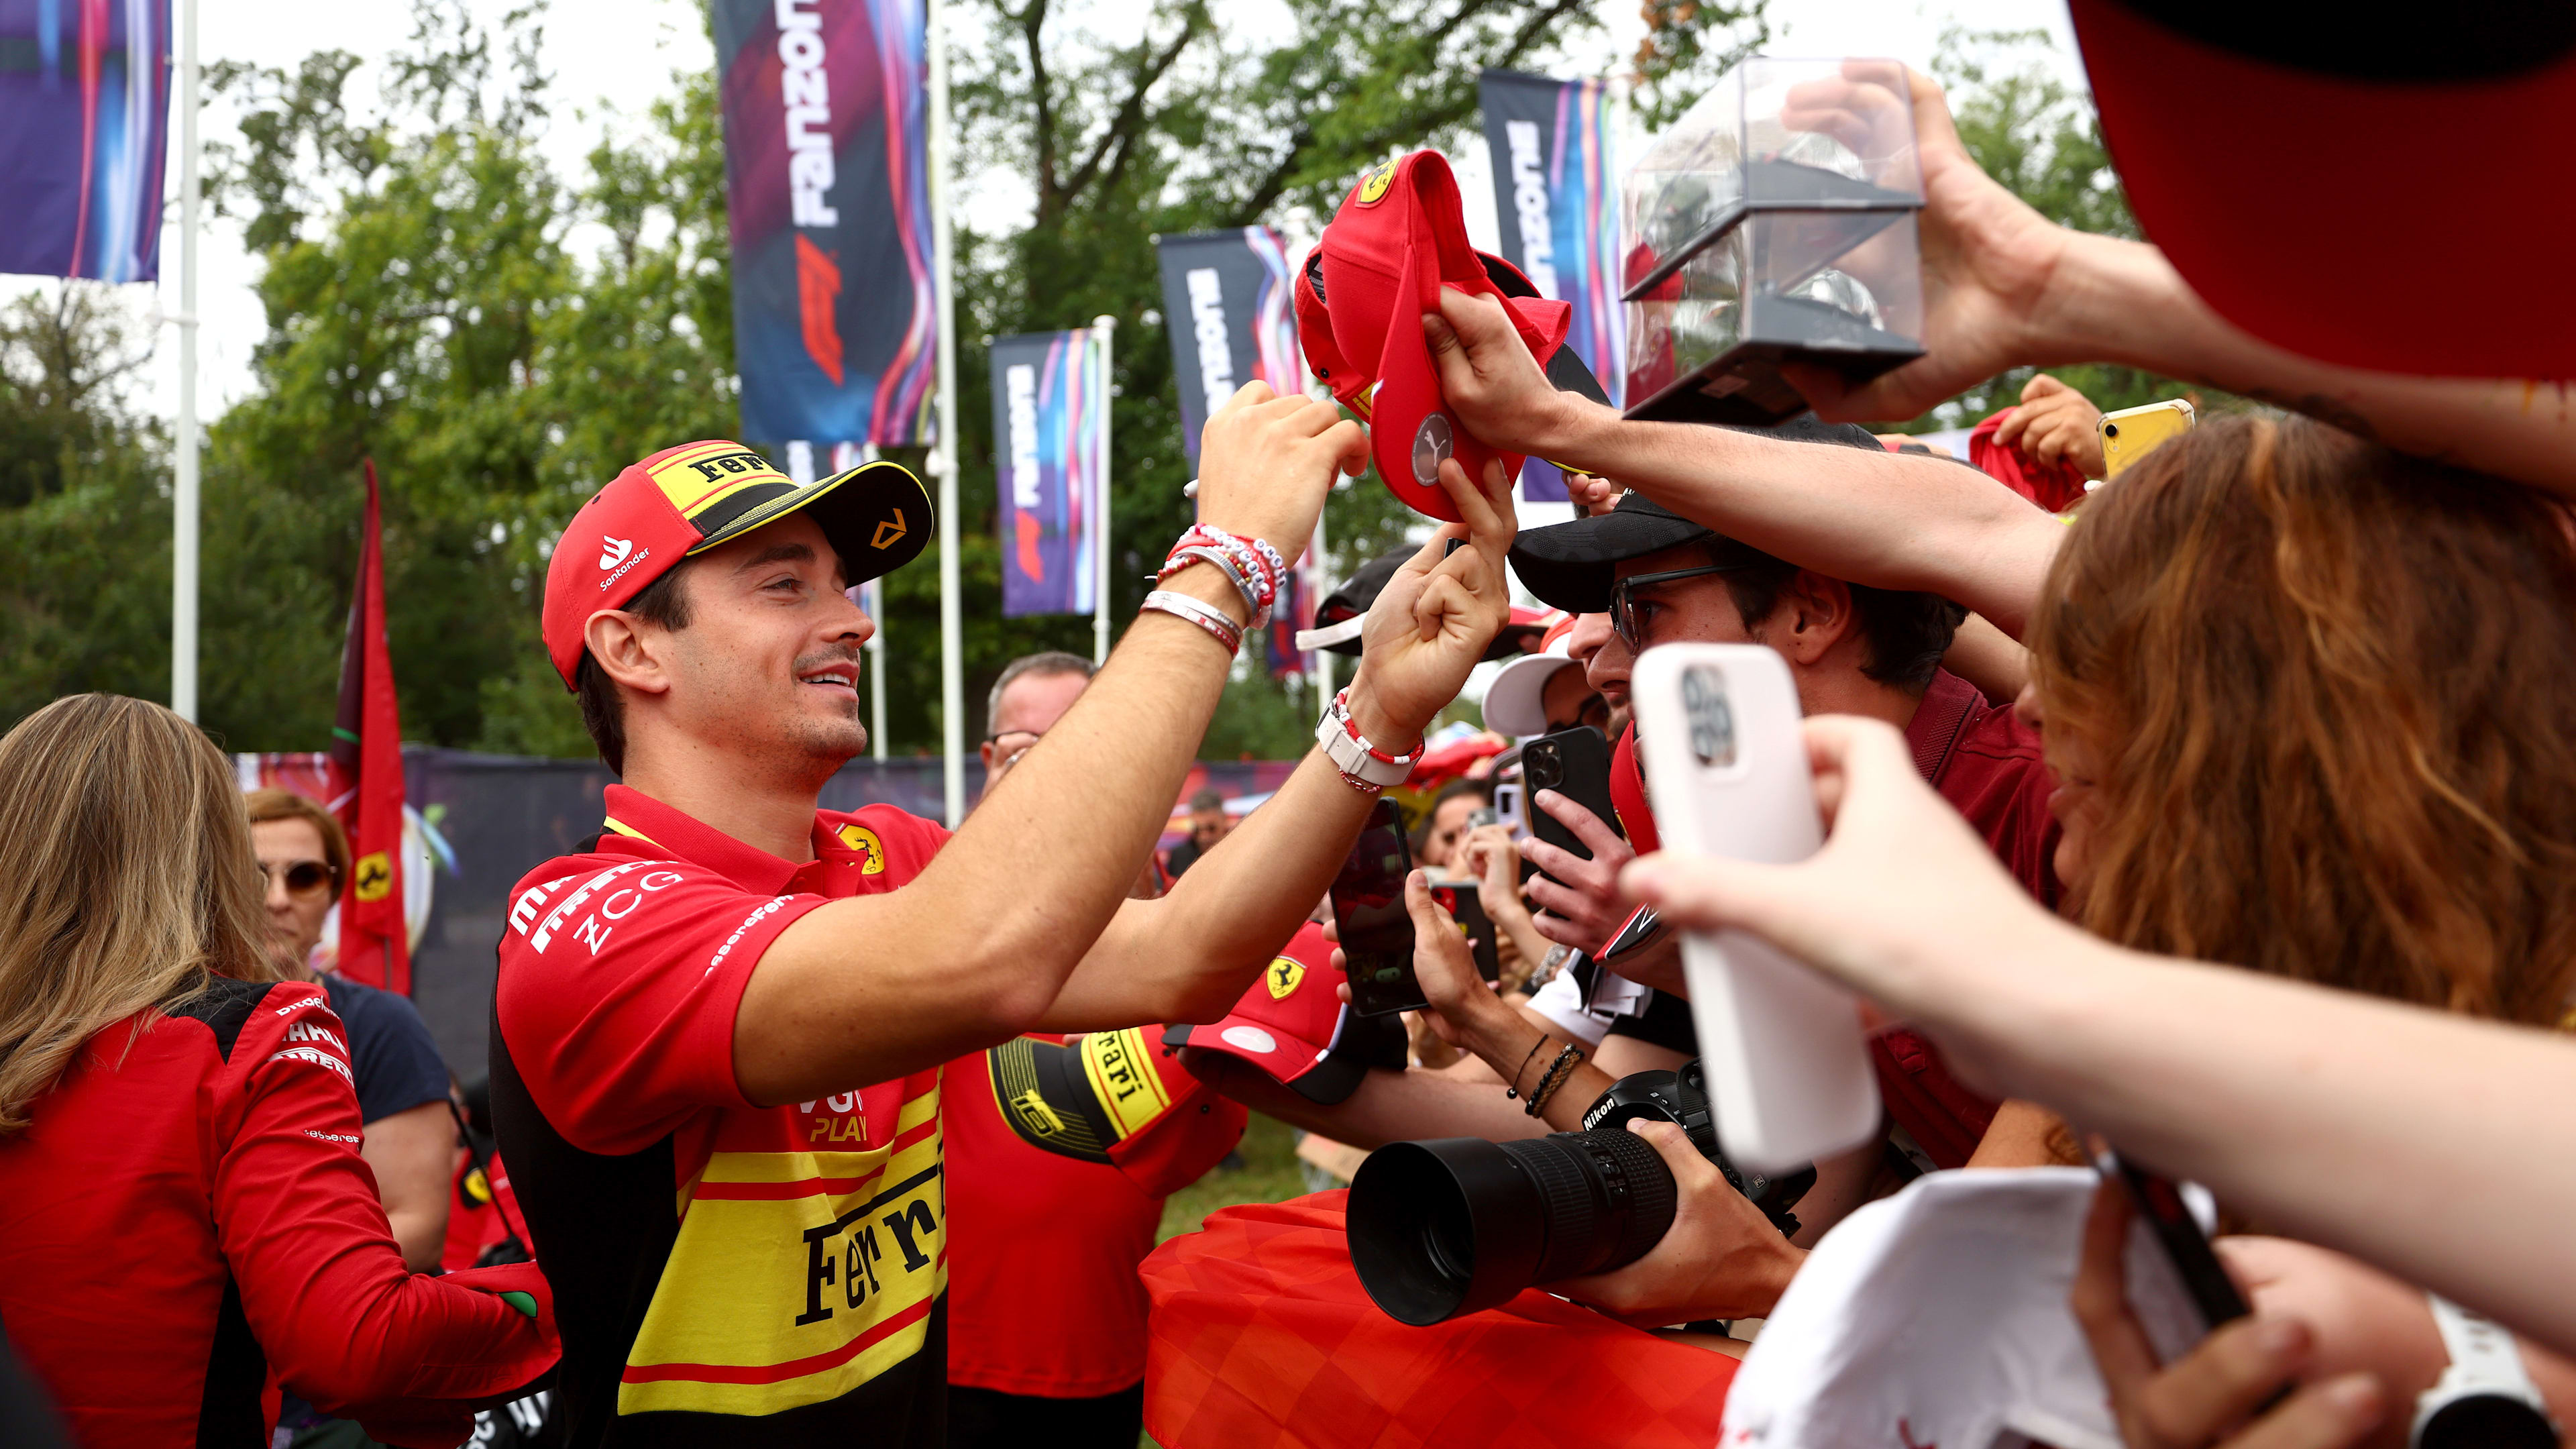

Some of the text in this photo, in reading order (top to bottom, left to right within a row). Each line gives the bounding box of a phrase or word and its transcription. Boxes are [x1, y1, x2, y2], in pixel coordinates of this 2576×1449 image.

[688, 453, 783, 483] Fer
[600, 547, 649, 592] Santander
[282, 1021, 347, 1057] AHLE
[1097, 1032, 1143, 1102] rari
[810, 1116, 867, 1142] PLAY
[1012, 1089, 1067, 1137] 16
[1583, 1097, 1615, 1131] Nikon
[796, 1166, 945, 1326] Ferr
